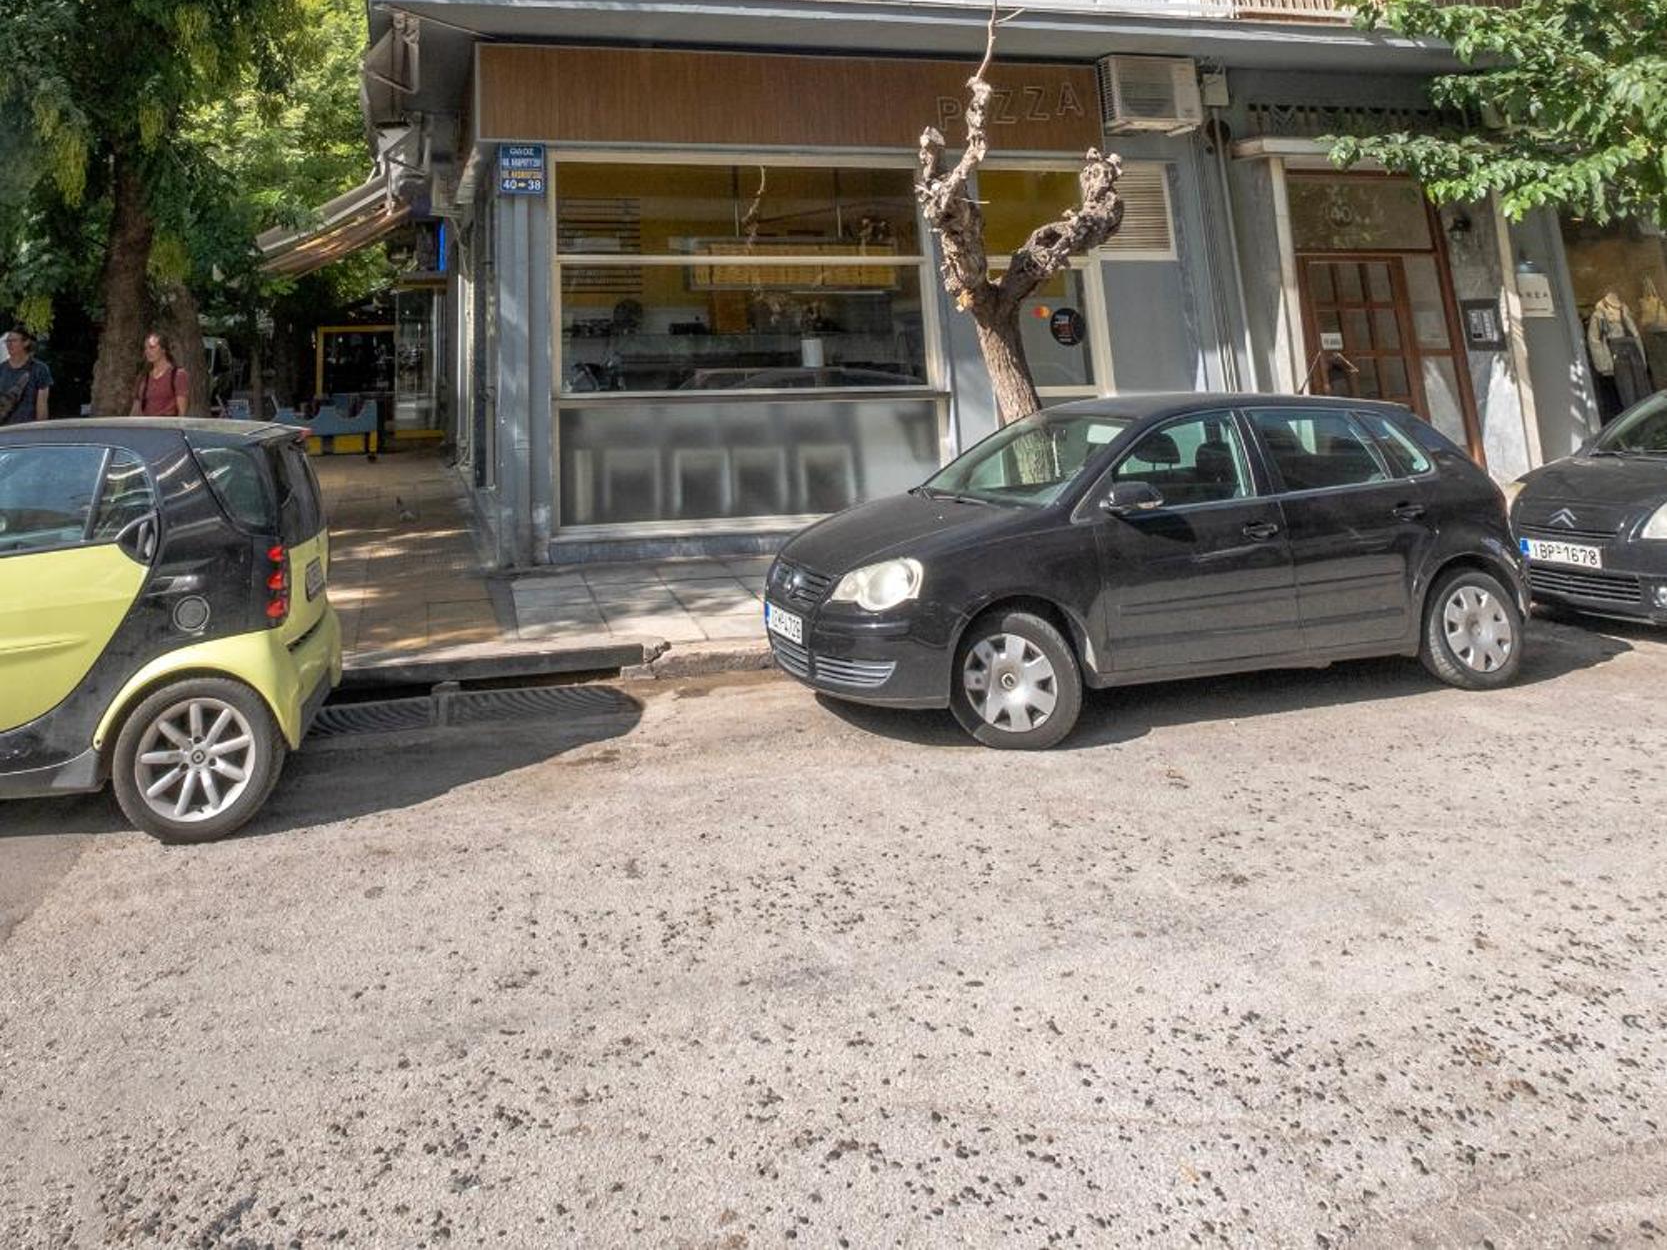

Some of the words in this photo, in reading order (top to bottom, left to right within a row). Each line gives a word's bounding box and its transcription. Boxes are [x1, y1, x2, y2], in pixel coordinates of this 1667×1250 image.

[937, 82, 1085, 131] PZZA
[503, 179, 517, 190] 40
[527, 179, 541, 191] 38
